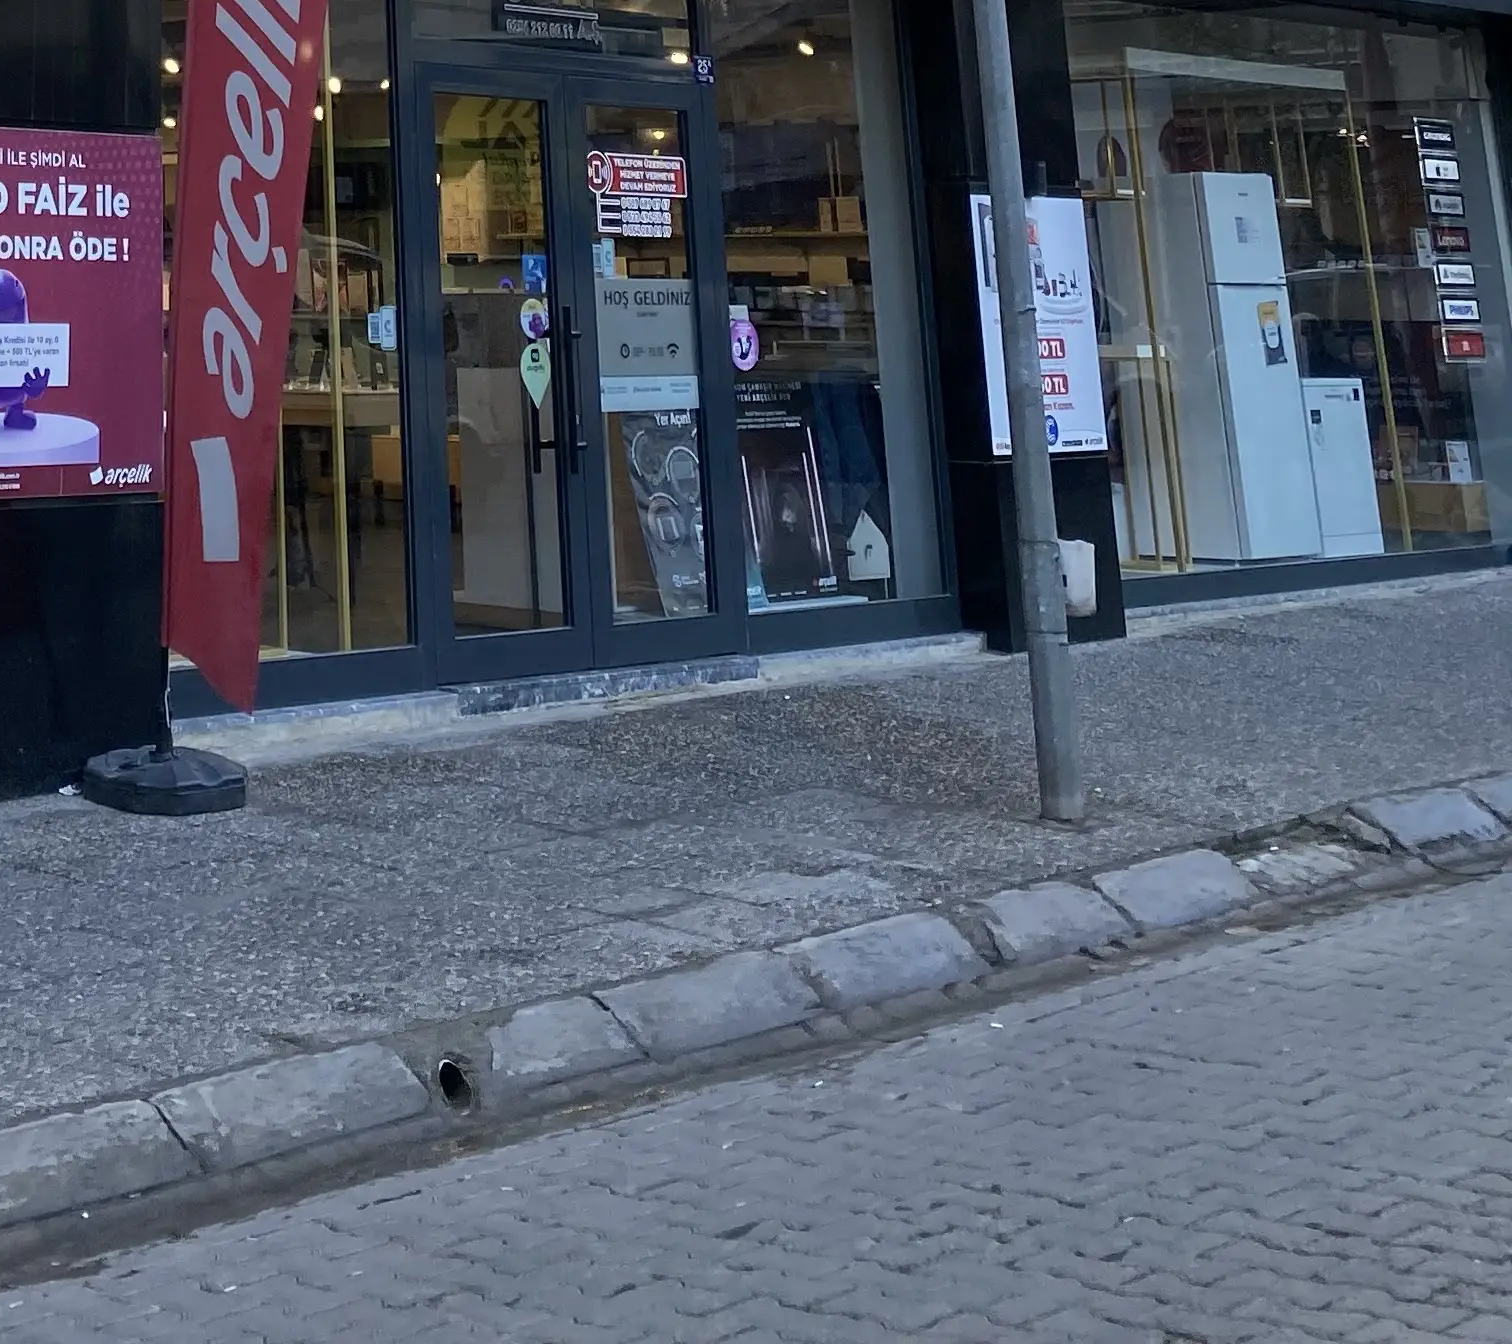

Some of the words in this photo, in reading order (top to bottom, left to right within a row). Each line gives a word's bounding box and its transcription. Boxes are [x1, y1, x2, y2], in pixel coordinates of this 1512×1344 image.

[7, 149, 27, 166] İLE
[30, 150, 66, 169] ŞİMDİ
[69, 153, 86, 168] AL
[613, 158, 643, 168] TELEFON
[18, 176, 88, 217] FAİZ
[95, 184, 131, 219] ile
[68, 229, 117, 261] ÖDE
[604, 290, 629, 309] HOŞ
[634, 288, 691, 306] GELDİNİZ
[1049, 341, 1063, 356] TL
[1053, 377, 1066, 393] TL
[105, 464, 152, 488] arçelik
